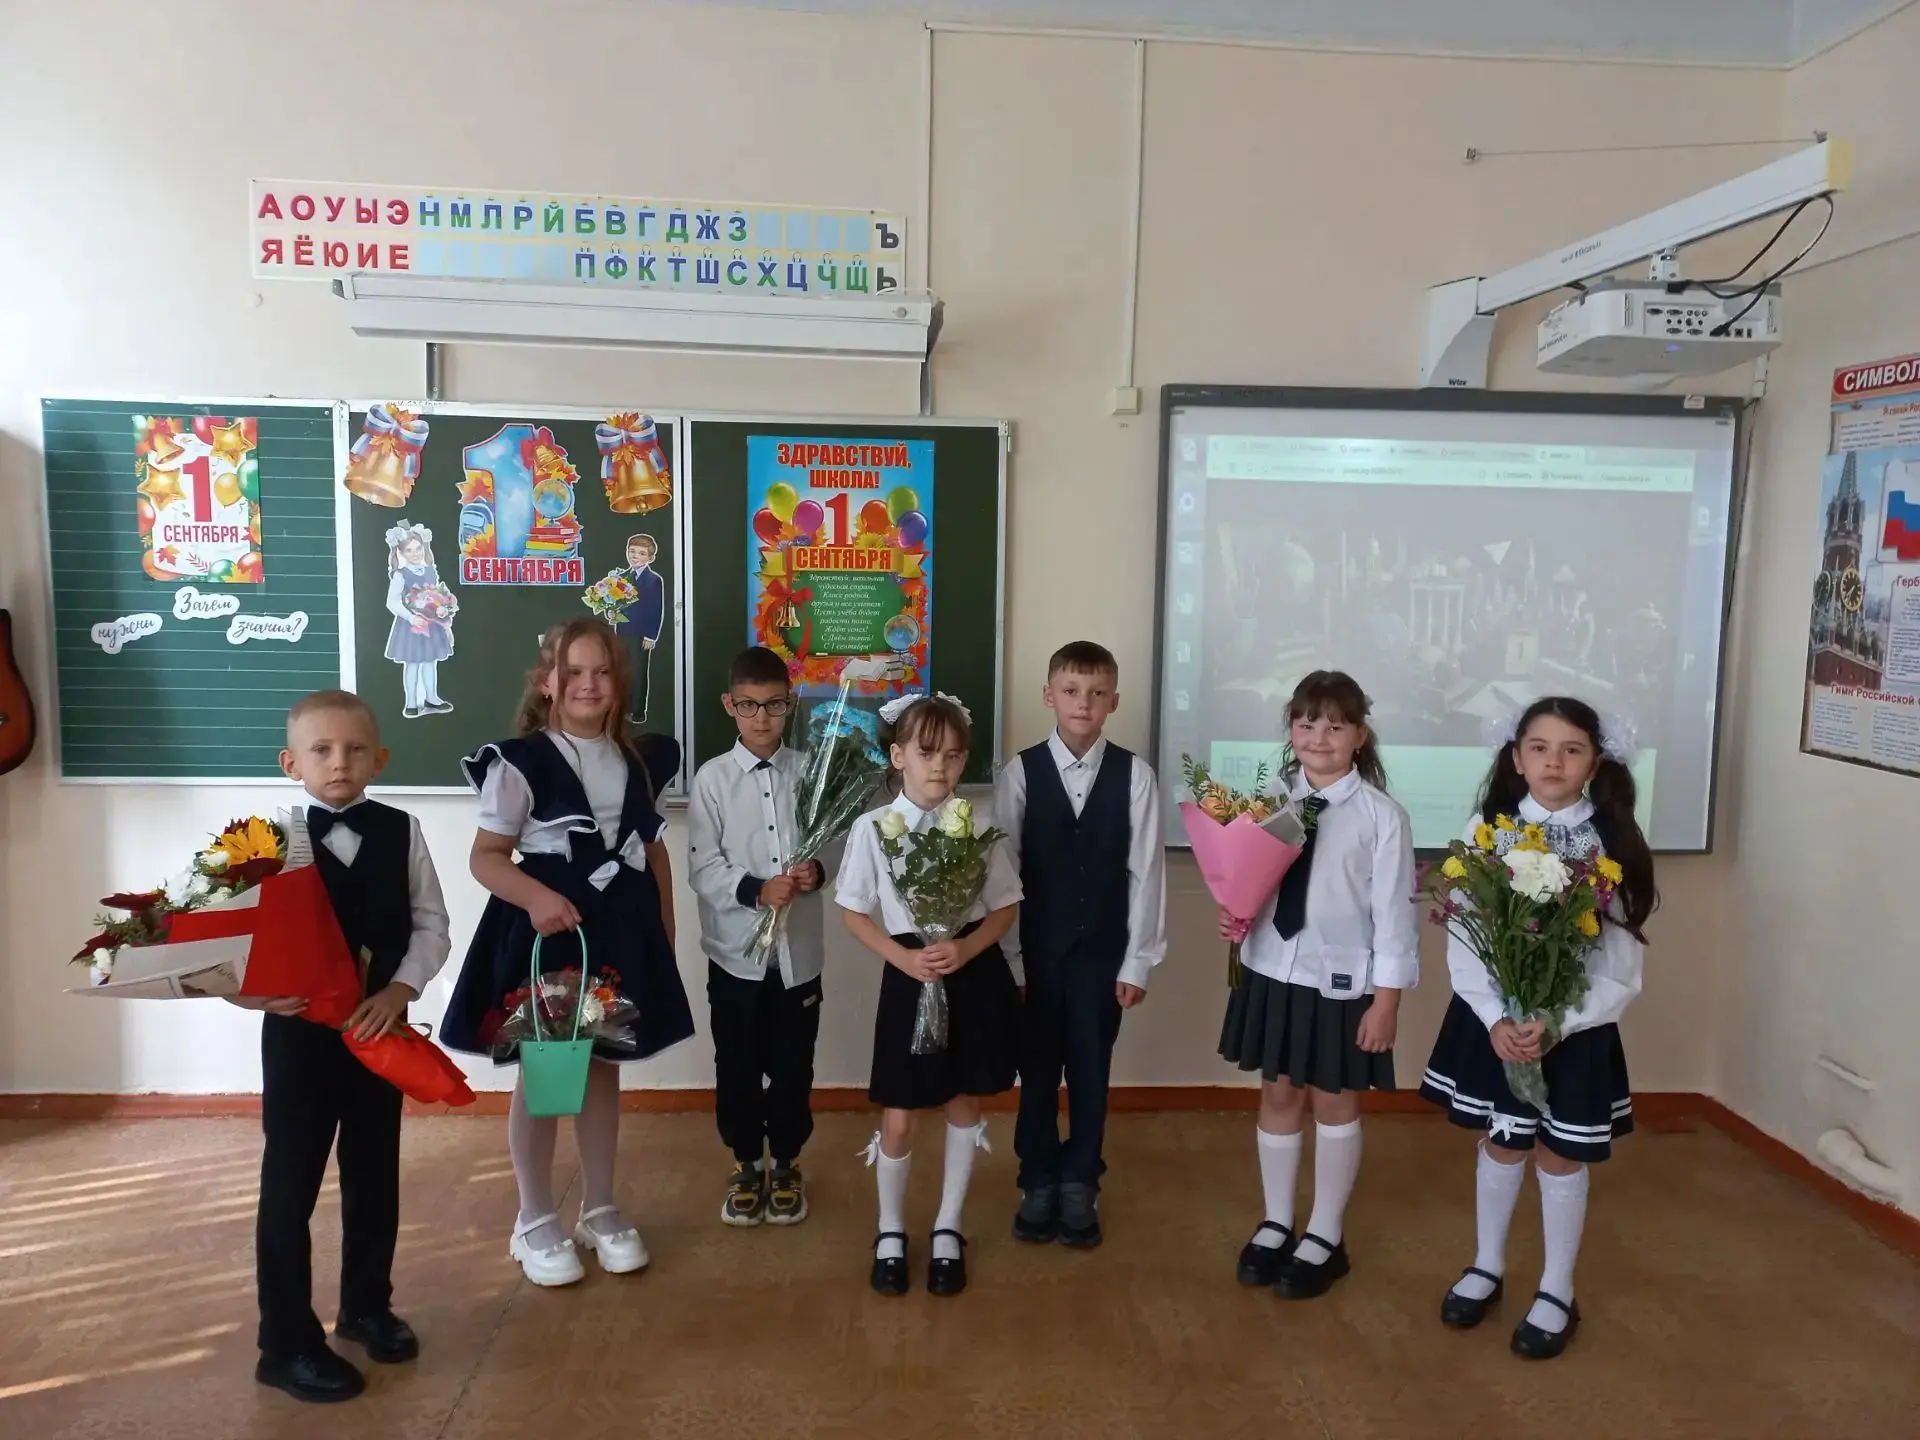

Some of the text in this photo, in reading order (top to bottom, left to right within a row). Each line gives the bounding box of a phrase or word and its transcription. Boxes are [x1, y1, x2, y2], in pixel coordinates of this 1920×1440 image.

[777, 441, 912, 468] ЗДРАВСТВУЙ,
[183, 456, 212, 522] 1
[463, 423, 536, 558] 1
[809, 470, 880, 489] ШКОЛА!
[825, 493, 854, 547] 1
[163, 524, 239, 543] СЕНТЯБРЯ
[796, 548, 891, 570] СЕНТЯБРЯ
[463, 559, 583, 584] СЕНТЯБРЯ
[180, 593, 232, 613] Зачем
[232, 618, 302, 638] знания?
[1831, 685, 1853, 696] Гимн
[1857, 688, 1914, 705] Российской
